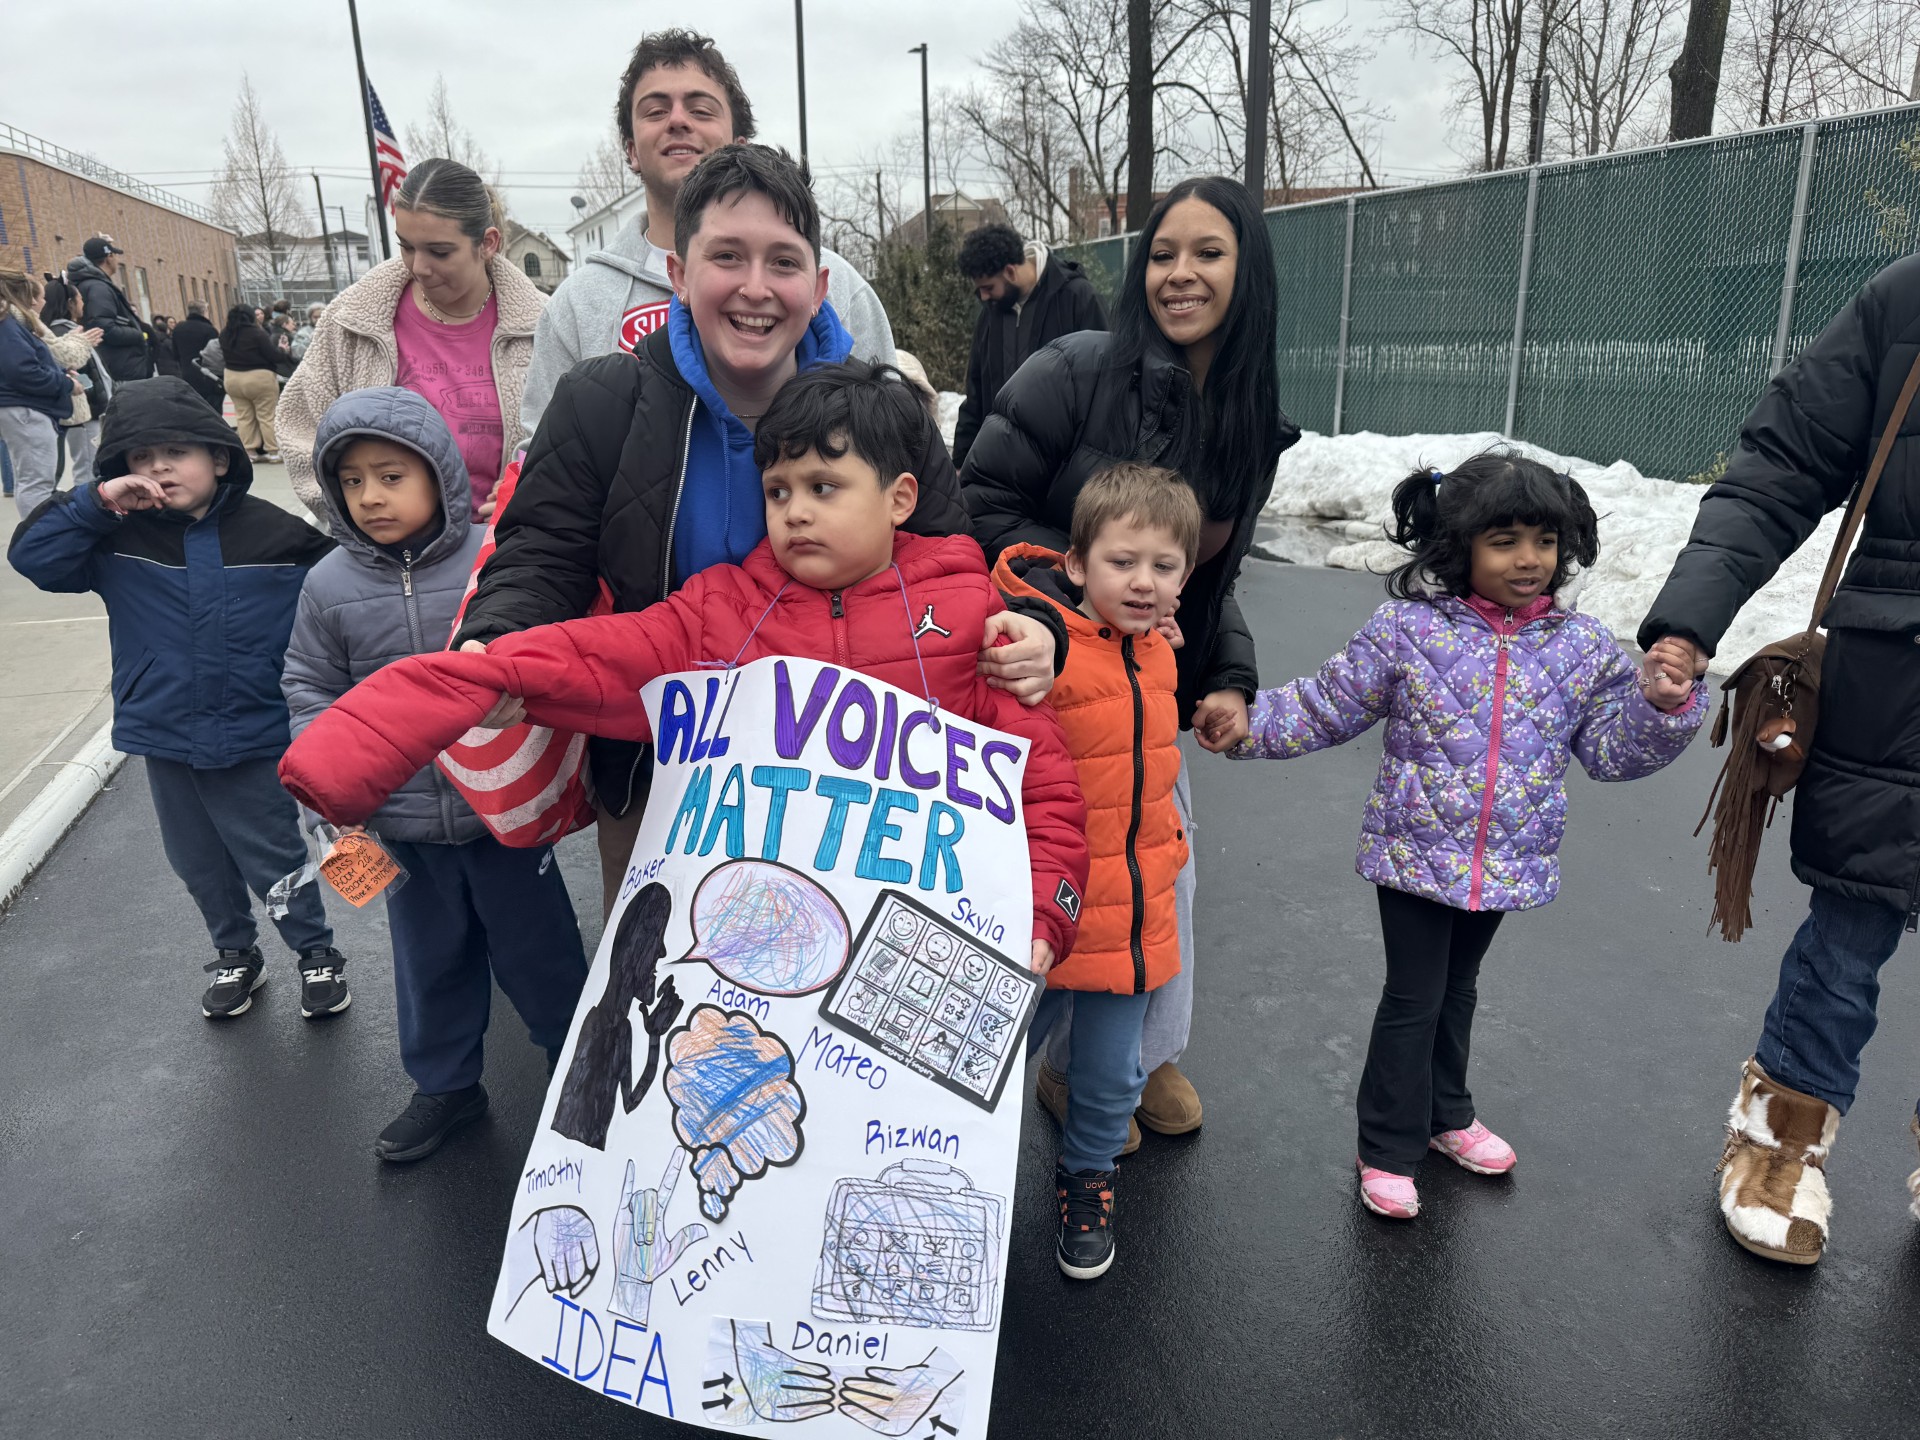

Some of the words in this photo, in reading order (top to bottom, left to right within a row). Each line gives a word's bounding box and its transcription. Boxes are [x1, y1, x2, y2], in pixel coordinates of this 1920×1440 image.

[656, 671, 741, 766] ALL
[773, 659, 1022, 825] VOICES
[664, 762, 966, 894] MATTER
[326, 858, 353, 880] CLASS
[333, 868, 358, 888] ROOM
[622, 857, 666, 900] Baker
[950, 897, 1006, 945] Skyla
[885, 933, 908, 951] Happy
[926, 957, 940, 969] Sad
[864, 969, 890, 990] Writing
[960, 978, 975, 991] Mad
[706, 978, 771, 1021] Adam
[901, 991, 928, 1012] Reading
[992, 998, 1013, 1015] Scared
[846, 1010, 868, 1027] Lunch
[940, 1015, 958, 1029] Math
[883, 1031, 904, 1048] Snack
[980, 1039, 992, 1049] Art
[795, 1025, 888, 1090] Mateo
[916, 1049, 949, 1073] Playground
[865, 1119, 960, 1160] Rizwan
[524, 1156, 584, 1195] Timothy
[669, 1229, 757, 1307] Lenny
[791, 1321, 889, 1361] Daniel
[541, 1293, 675, 1418] IDEA
